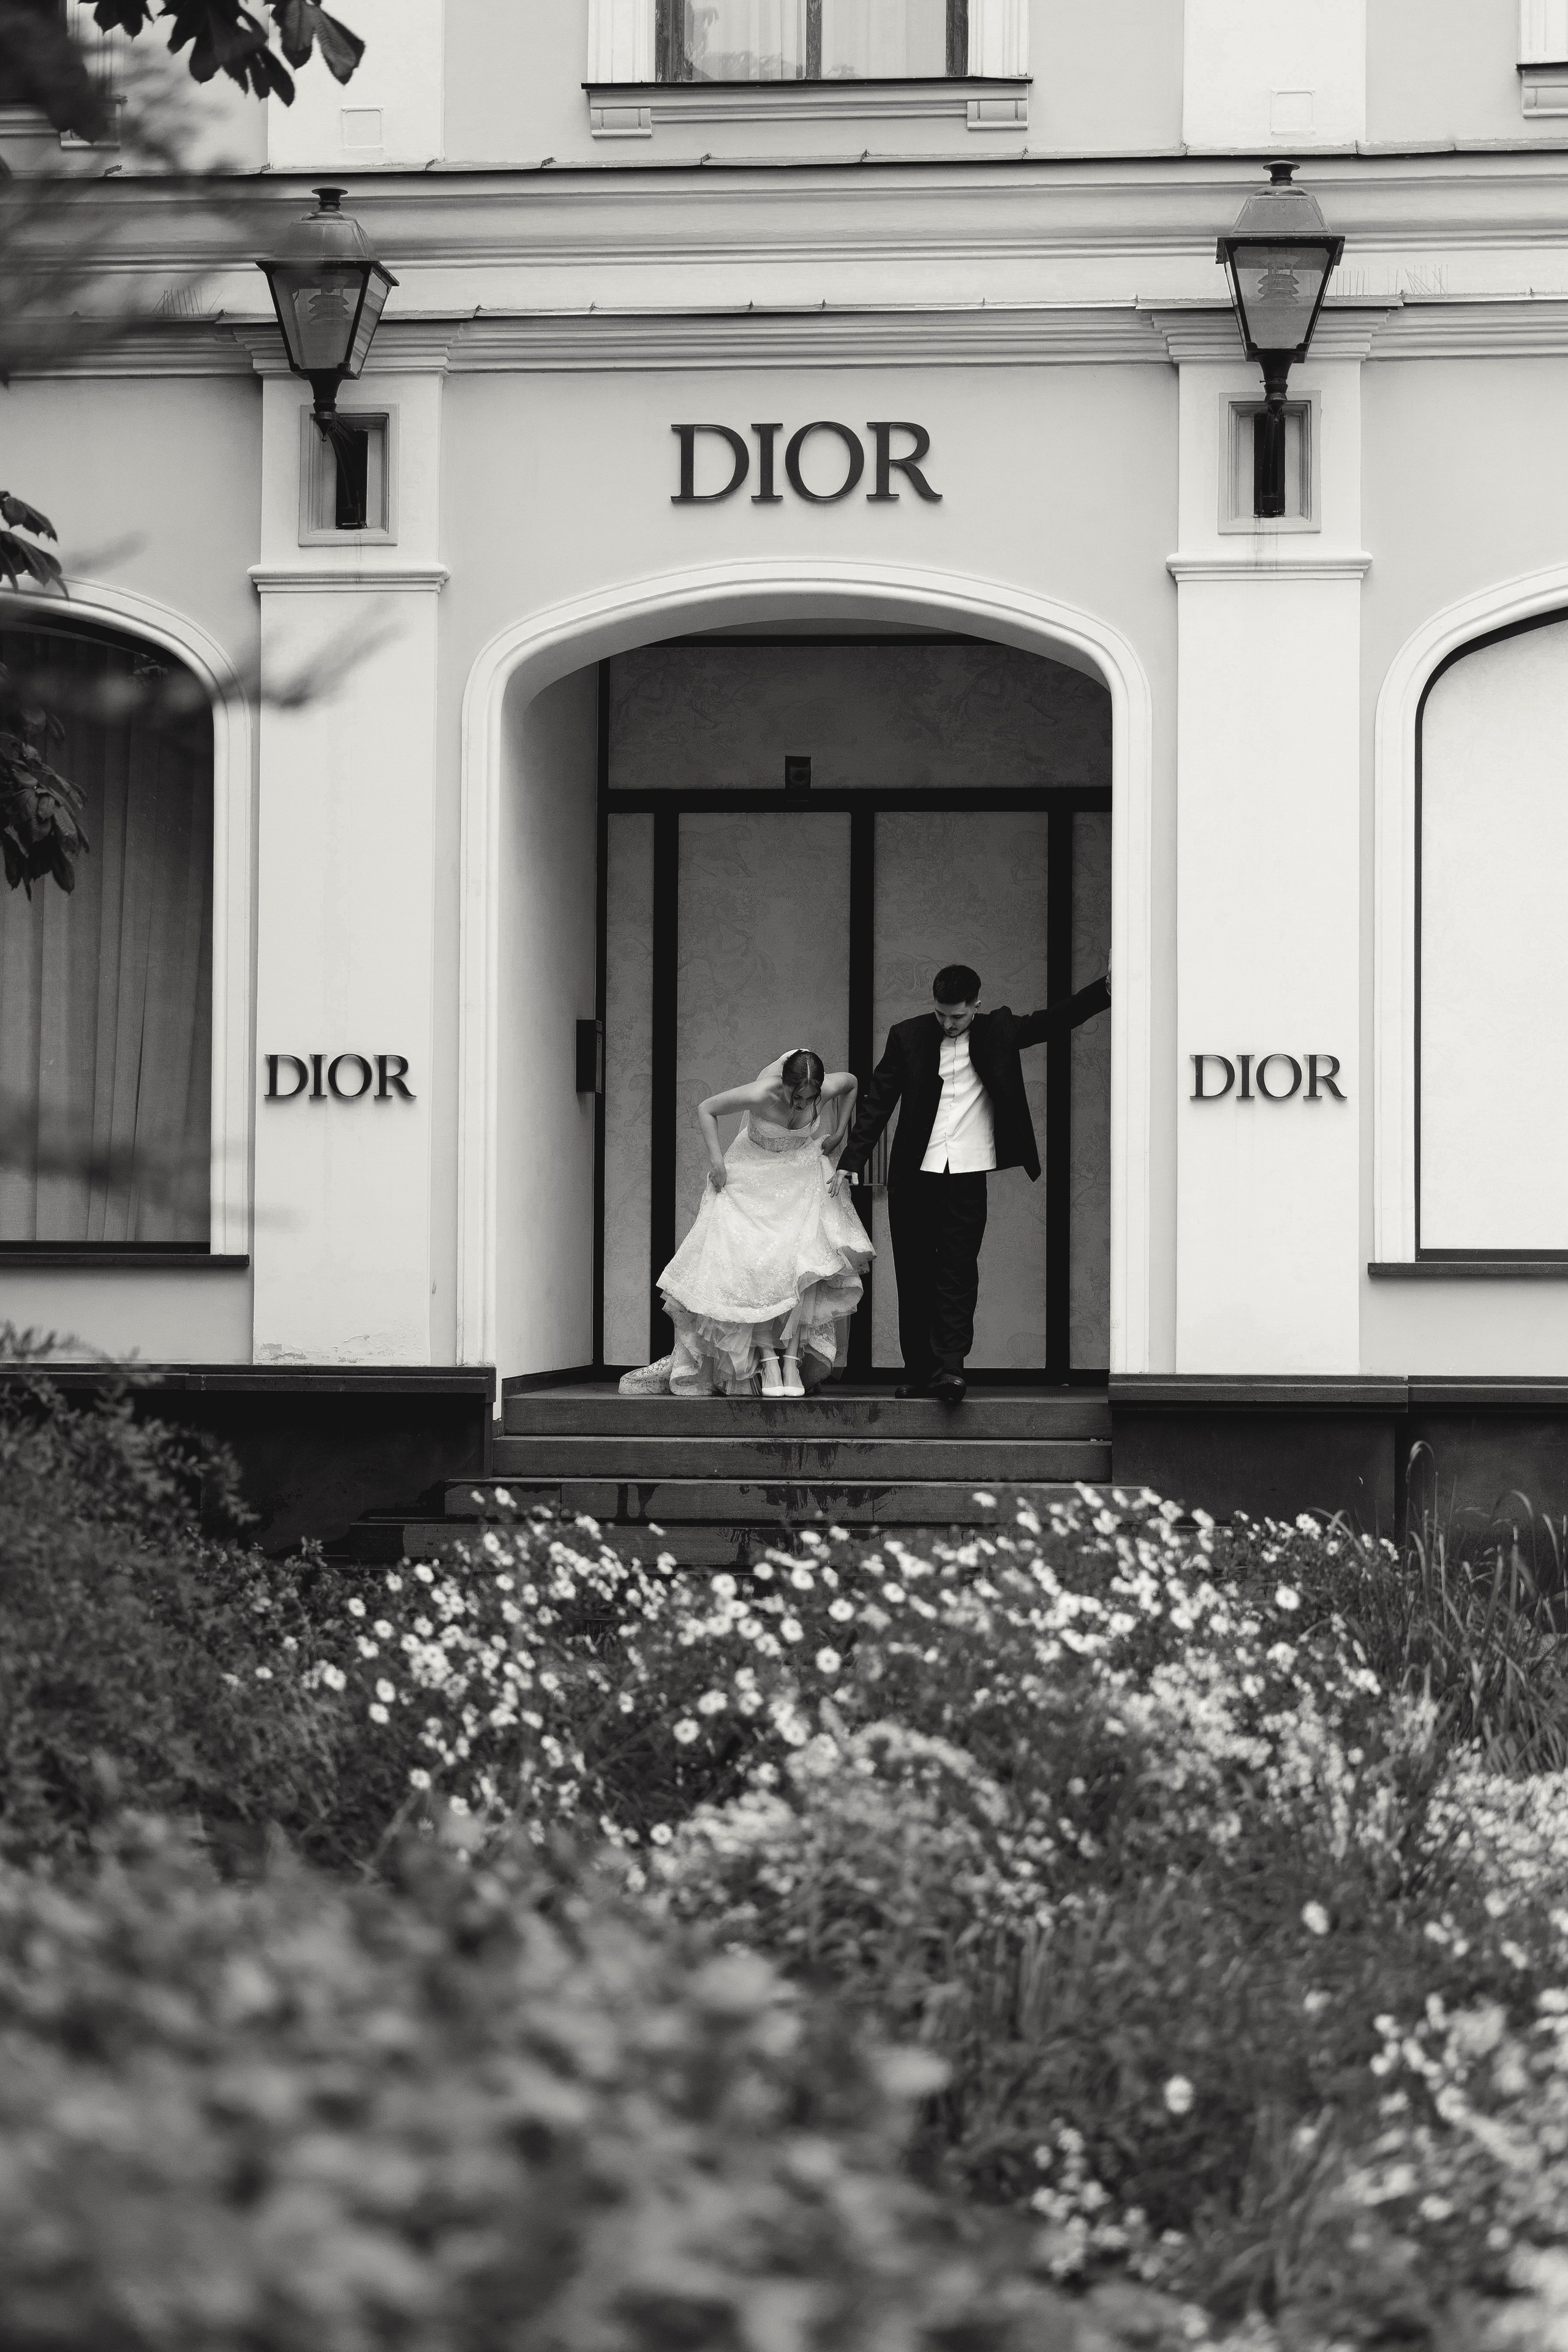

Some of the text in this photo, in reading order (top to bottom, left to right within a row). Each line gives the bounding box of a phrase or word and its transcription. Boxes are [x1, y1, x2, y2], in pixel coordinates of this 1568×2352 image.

[671, 421, 943, 502] DIOR
[264, 1054, 417, 1099] DIOR
[1189, 1054, 1348, 1100] DIOR
